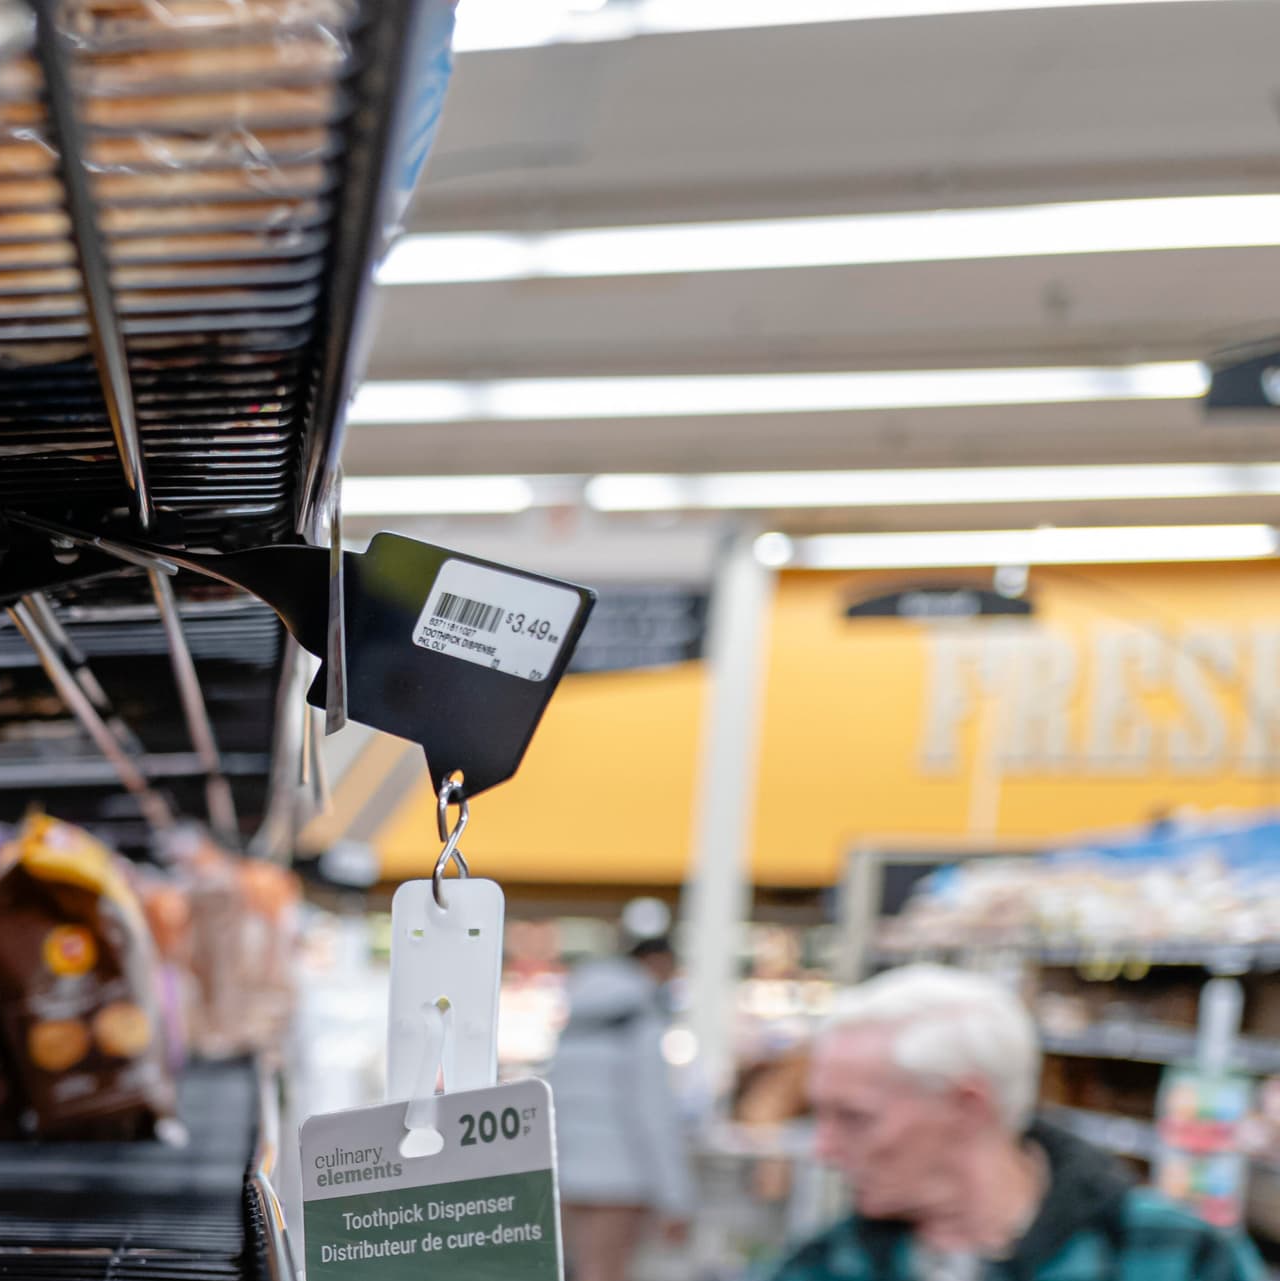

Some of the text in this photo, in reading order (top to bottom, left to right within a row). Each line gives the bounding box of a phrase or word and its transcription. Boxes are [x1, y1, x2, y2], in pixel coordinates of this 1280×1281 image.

[505, 611, 551, 641] $3.49
[422, 626, 497, 657] TOOTHPICK DISPENSE
[458, 1106, 537, 1147] 200 CT
[523, 1125, 531, 1136] P
[314, 1146, 383, 1169] culinary
[316, 1162, 403, 1188] elements
[342, 1195, 516, 1231] Toothpick Dispenser
[321, 1222, 542, 1263] Distributeur de cure-dents
